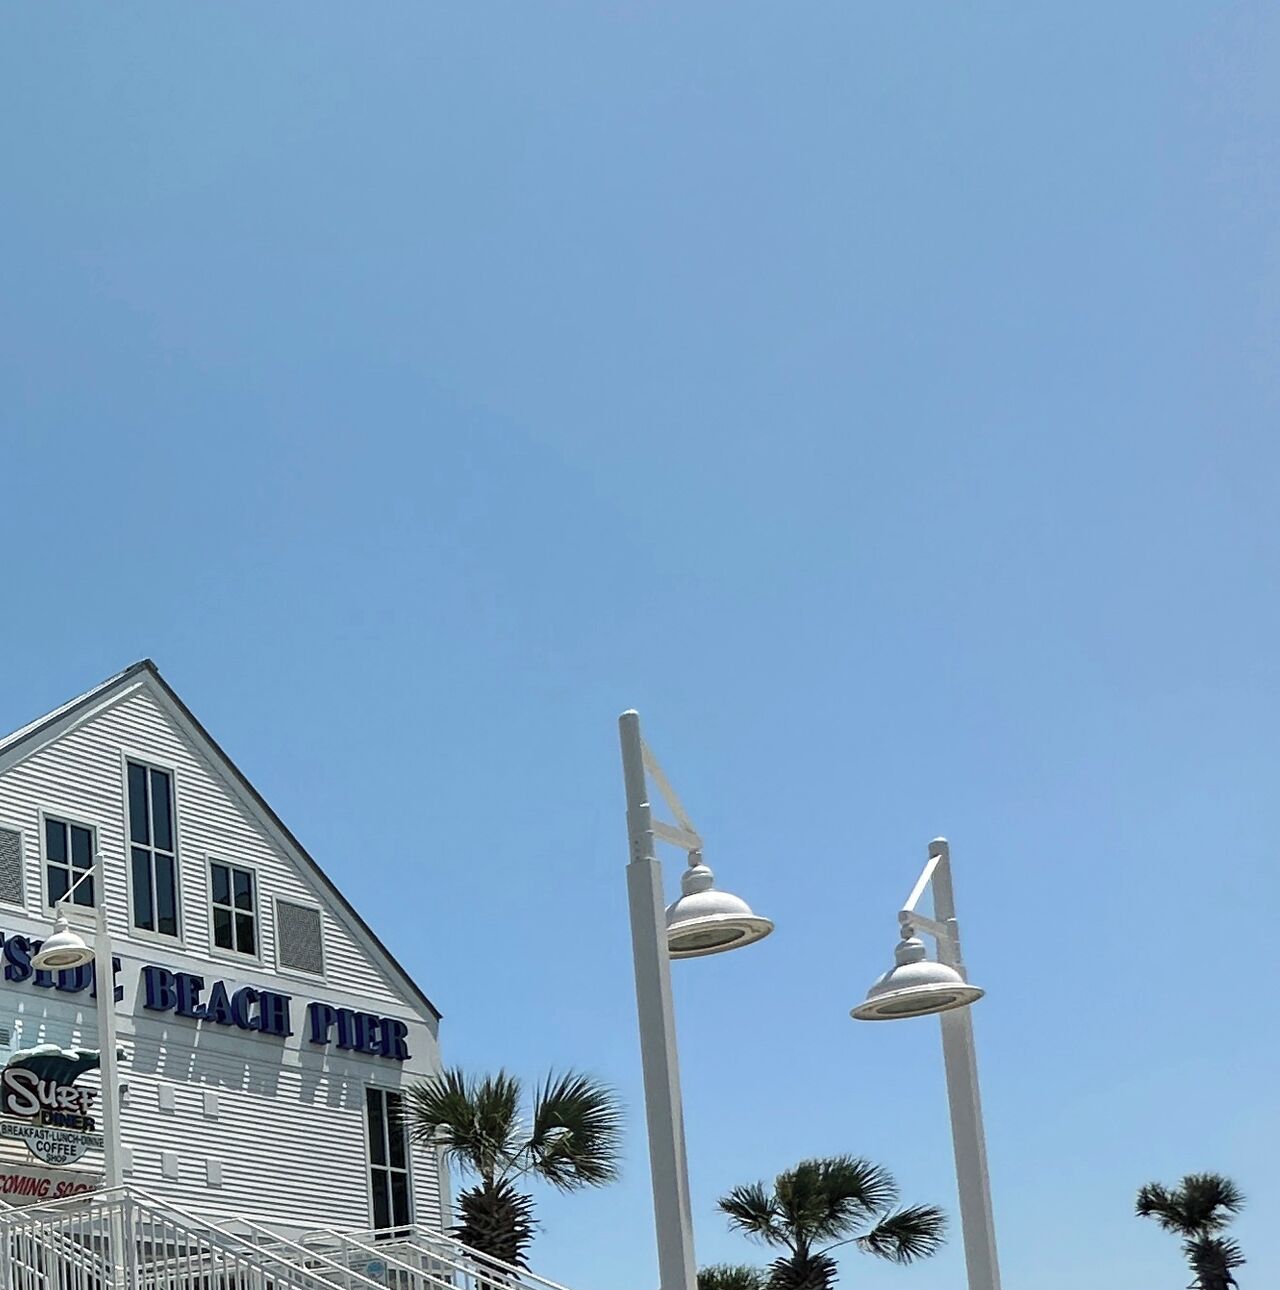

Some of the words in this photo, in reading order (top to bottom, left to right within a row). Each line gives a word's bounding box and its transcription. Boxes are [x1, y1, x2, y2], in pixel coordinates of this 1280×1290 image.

[141, 965, 294, 1037] BEACH
[307, 1001, 412, 1061] PIER
[41, 1110, 96, 1132] DINER
[36, 1140, 77, 1156] COFFEE
[46, 1154, 67, 1163] SHOP
[53, 1180, 97, 1199] SOO
